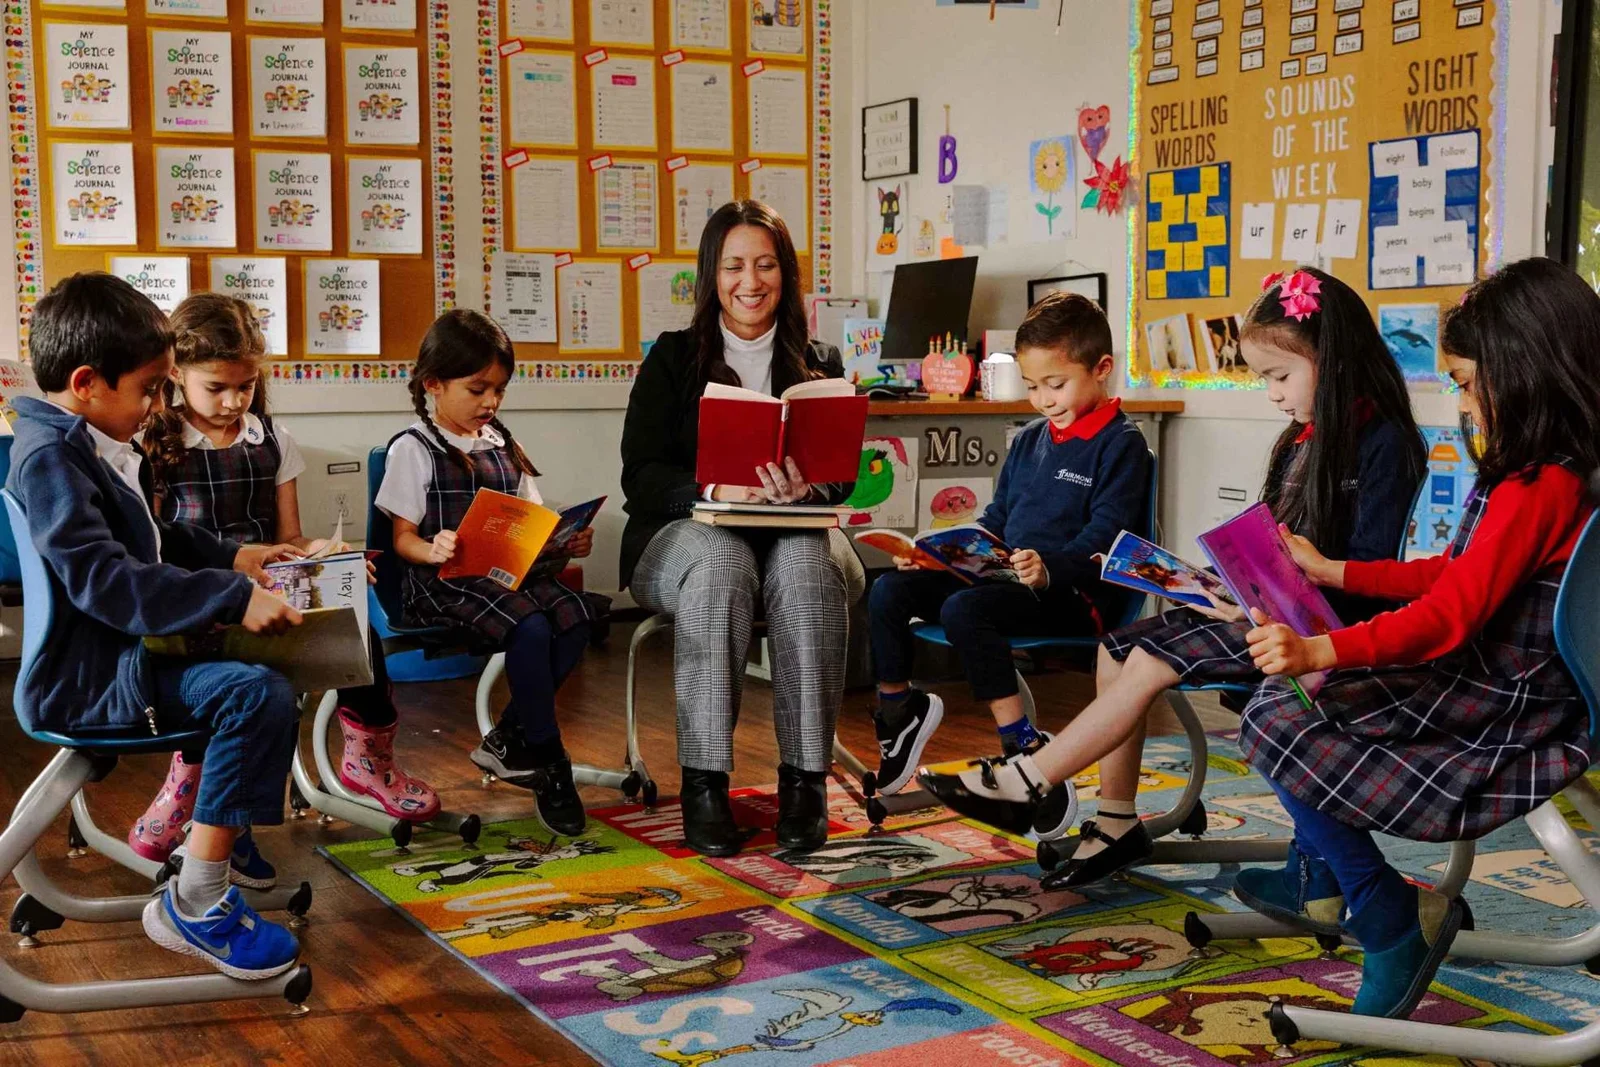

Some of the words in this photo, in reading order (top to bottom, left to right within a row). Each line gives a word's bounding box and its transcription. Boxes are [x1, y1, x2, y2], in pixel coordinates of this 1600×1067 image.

[1400, 8, 1413, 16] we
[1462, 14, 1478, 22] you
[80, 31, 94, 39] MY
[61, 39, 116, 58] Science
[186, 38, 199, 46] MY
[1340, 38, 1356, 51] the
[167, 46, 220, 64] Science
[264, 53, 314, 70] Science
[375, 54, 388, 62] MY
[67, 61, 110, 71] JOURNAL
[173, 67, 214, 77] JOURNAL
[358, 62, 407, 79] Science
[270, 73, 308, 82] JOURNAL
[1407, 52, 1478, 96] SIGHT
[364, 82, 402, 91] JOURNAL
[1264, 74, 1356, 120] SOUNDS
[57, 112, 70, 122] By:
[162, 116, 173, 125] By:
[1150, 95, 1228, 135] SPELLING
[1404, 95, 1479, 134] WORDS
[260, 121, 271, 130] By:
[355, 129, 366, 138] By:
[1272, 123, 1297, 159] OF
[1312, 117, 1350, 153] THE
[86, 150, 100, 158] MY
[1154, 132, 1216, 168] WORDS
[1440, 147, 1468, 157] follow
[189, 154, 202, 162] MY
[287, 160, 300, 168] MY
[938, 135, 958, 184] B
[1386, 154, 1406, 166] eight
[67, 157, 121, 177] Science
[170, 162, 222, 181] Science
[379, 166, 392, 174] MY
[269, 167, 319, 185] Science
[362, 173, 410, 190] Science
[1271, 162, 1338, 200] WEEK
[74, 179, 116, 188] JOURNAL
[176, 183, 217, 192] JOURNAL
[1412, 178, 1433, 190] baby
[274, 188, 313, 197] JOURNAL
[367, 193, 405, 202] JOURNAL
[1408, 207, 1435, 219] begins
[1250, 224, 1265, 237] ur
[1292, 227, 1308, 240] er
[1335, 219, 1347, 236] ir
[64, 230, 76, 240] By:
[166, 232, 177, 241] By:
[263, 235, 275, 244] By:
[1433, 233, 1453, 244] until
[356, 239, 367, 247] By:
[1386, 237, 1408, 250] years
[143, 264, 157, 272] MY
[242, 264, 256, 272] MY
[336, 266, 349, 274] MY
[1379, 264, 1411, 276] learning
[1437, 261, 1463, 274] young
[126, 272, 176, 290] Science
[224, 272, 275, 290] Science
[319, 274, 368, 291] Science
[325, 294, 362, 302] JOURNAL
[314, 340, 325, 348] By:
[855, 341, 877, 357] DAY
[926, 429, 998, 467] Ms.
[337, 571, 357, 599] they
[724, 855, 809, 893] Sunday
[1507, 866, 1570, 885] April
[645, 864, 725, 899] umbrella
[1484, 872, 1537, 890] May
[735, 908, 805, 941] turtle
[814, 896, 921, 943] Monday
[840, 964, 915, 998] socks
[935, 945, 1050, 1005] Tuesday
[603, 997, 754, 1053] Ss
[1065, 1011, 1196, 1067] Wednesd
